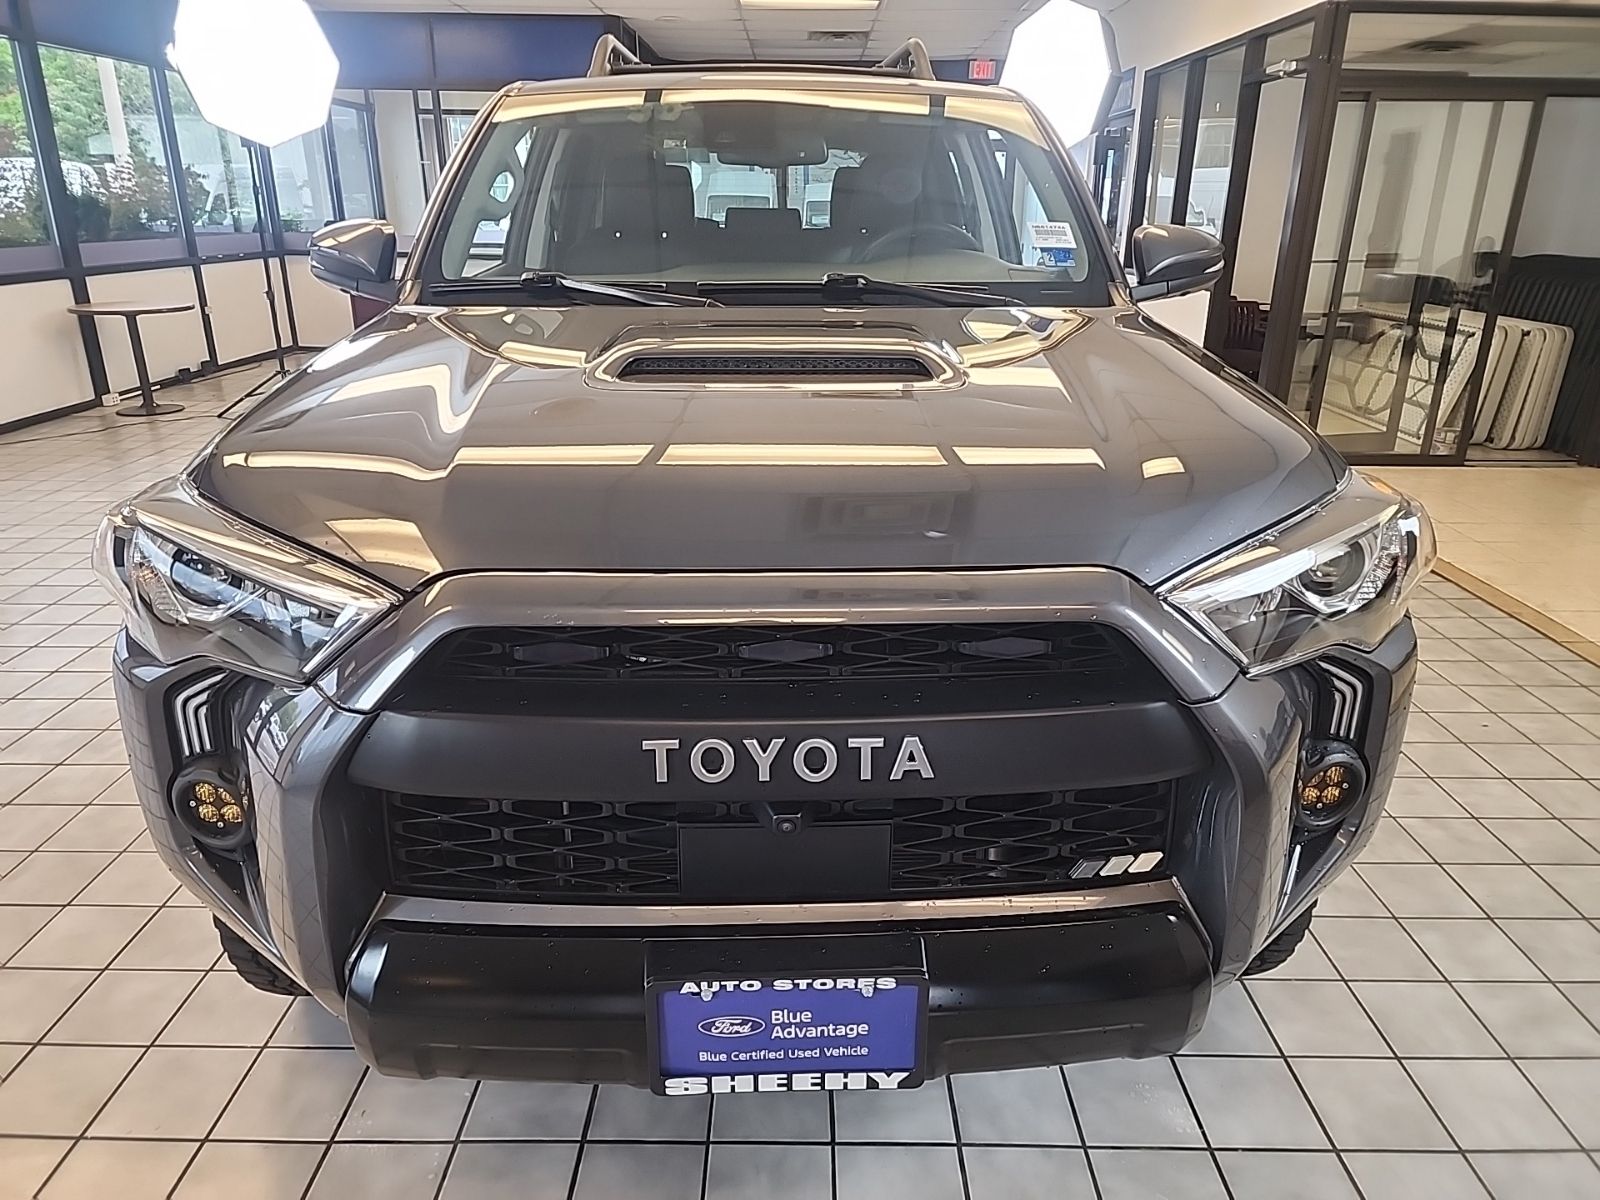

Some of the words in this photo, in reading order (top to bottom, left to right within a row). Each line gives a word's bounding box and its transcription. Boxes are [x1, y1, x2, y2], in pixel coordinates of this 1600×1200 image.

[974, 61, 994, 79] EXIT
[642, 736, 935, 783] TOYOTA
[679, 980, 763, 995] AUTO
[772, 977, 897, 991] STORES
[771, 1009, 812, 1024] Blue
[710, 1018, 752, 1034] Ford
[771, 1022, 869, 1040] Advantage
[699, 1051, 727, 1062] Blue
[731, 1049, 784, 1061] Certified
[788, 1047, 820, 1059] Used
[824, 1045, 869, 1058] Vehicle
[664, 1071, 910, 1096] SHEEHY
